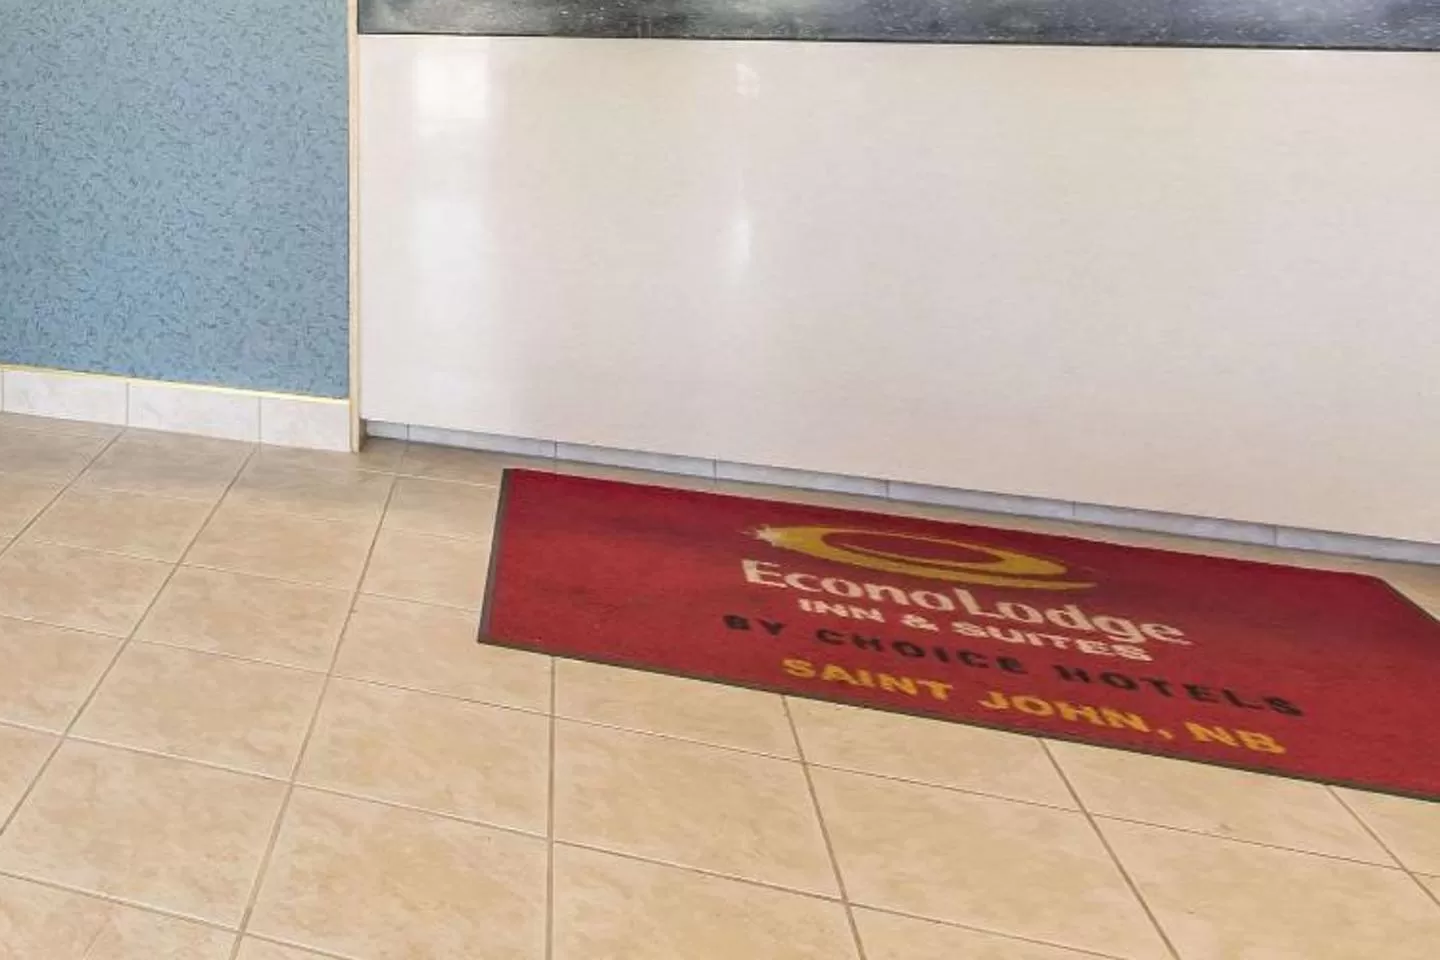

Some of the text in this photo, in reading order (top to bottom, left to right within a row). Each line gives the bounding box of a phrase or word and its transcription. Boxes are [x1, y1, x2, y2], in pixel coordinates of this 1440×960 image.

[741, 558, 1194, 646] EconoLodge
[798, 598, 1153, 662] INN & SUITES
[723, 614, 1303, 717] BY CHOICE HOTELS
[781, 657, 1287, 755] SAINT JOHN, NB
